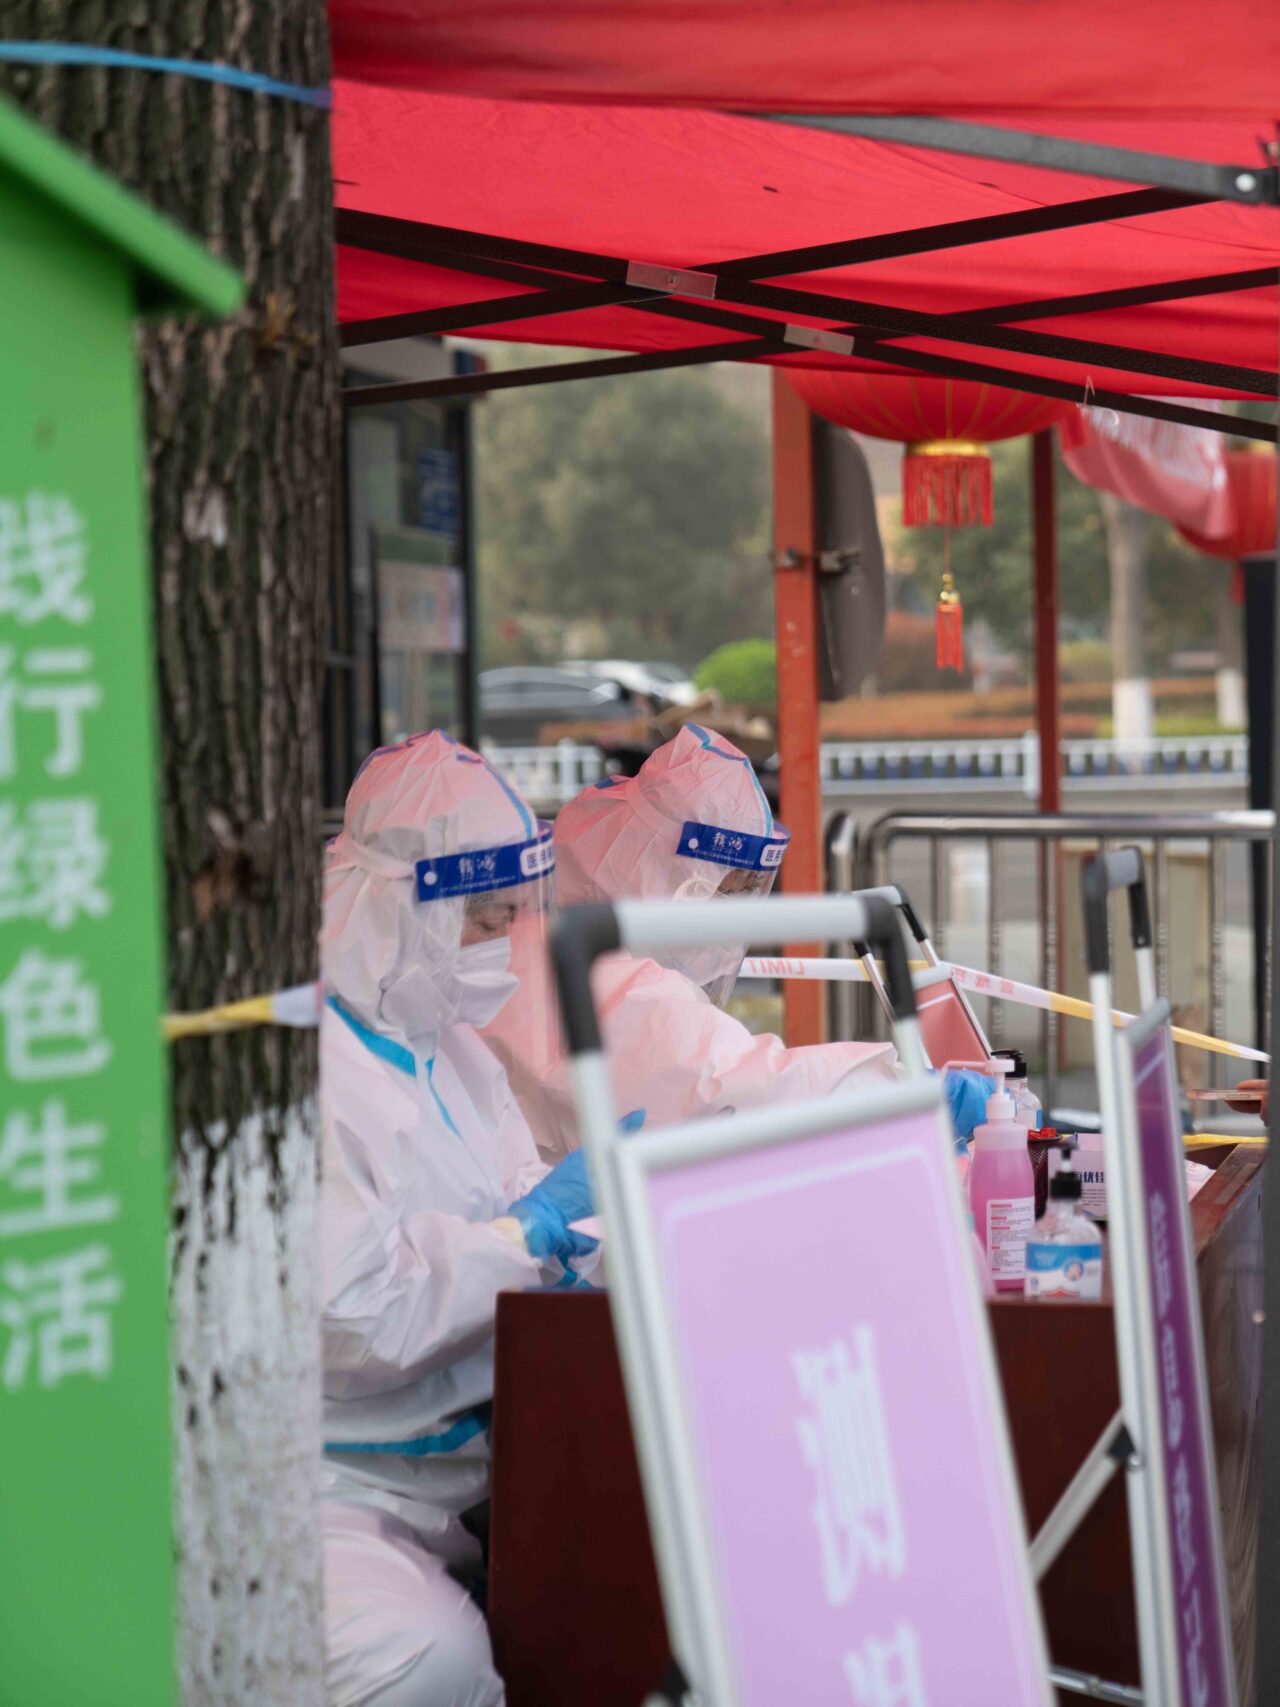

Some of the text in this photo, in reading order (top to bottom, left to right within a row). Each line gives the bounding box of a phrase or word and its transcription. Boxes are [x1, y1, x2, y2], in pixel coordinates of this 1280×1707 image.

[0, 491, 121, 1389] 践行绿色生活
